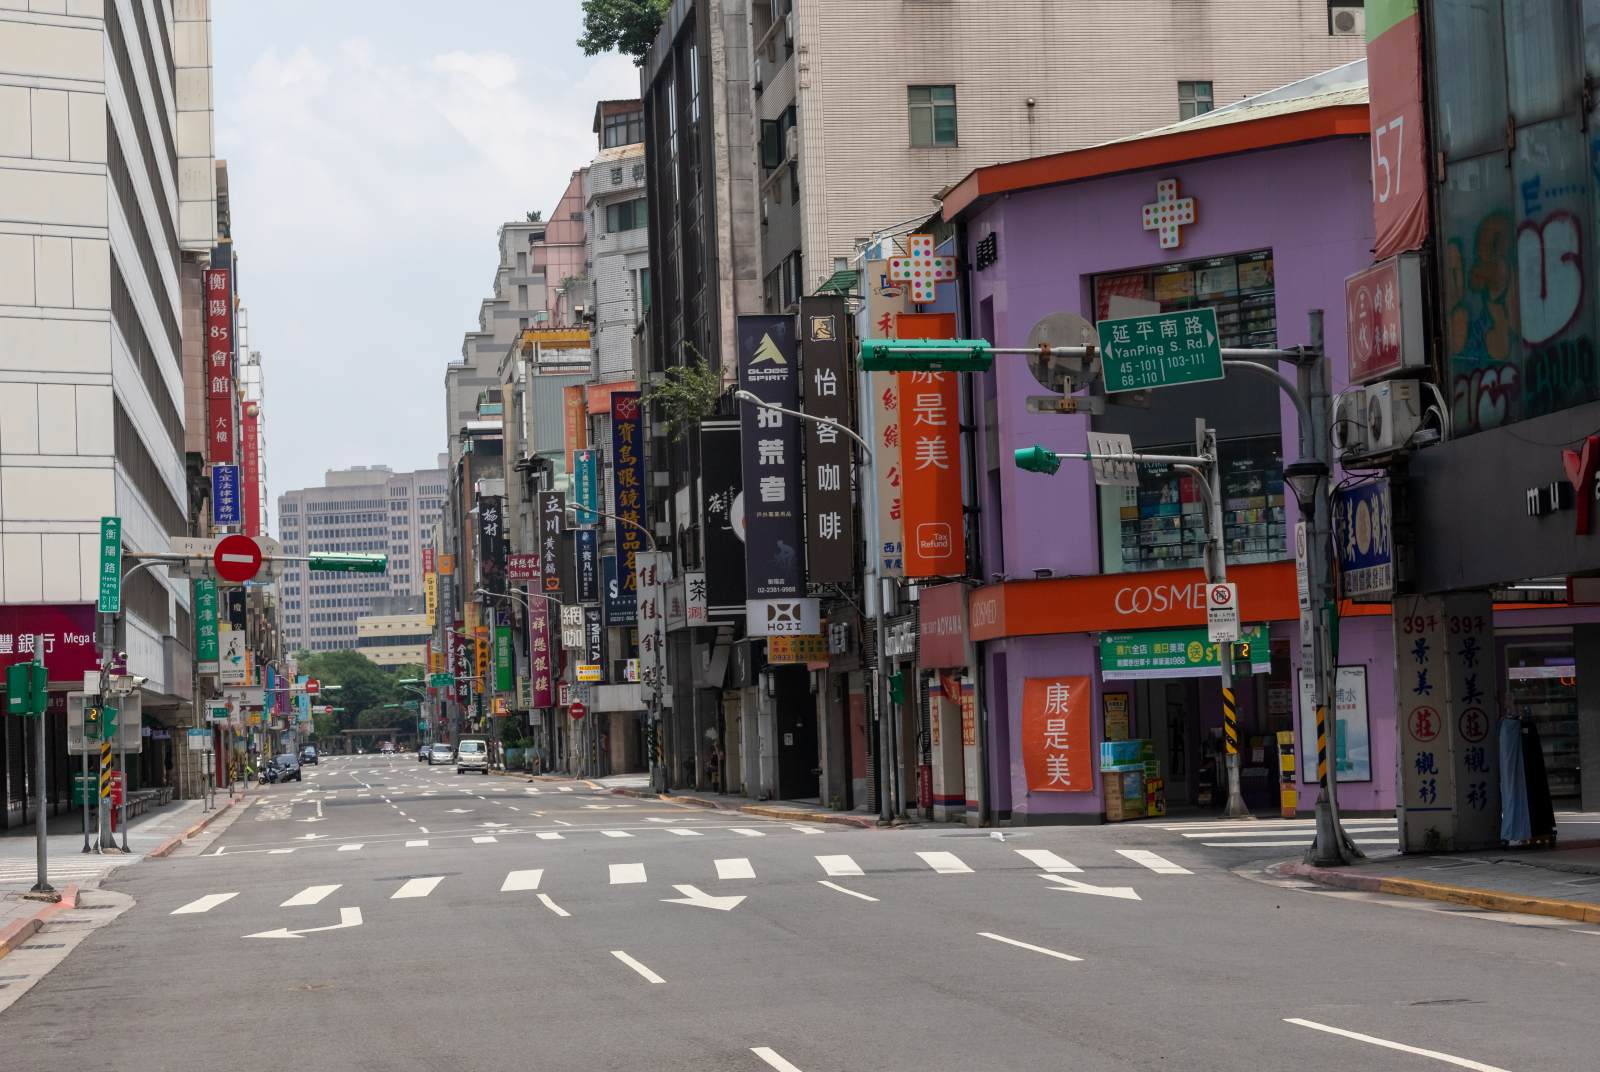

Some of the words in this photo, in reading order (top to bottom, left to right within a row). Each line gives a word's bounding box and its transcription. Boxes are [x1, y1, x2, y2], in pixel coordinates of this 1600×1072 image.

[208, 273, 228, 393] 衡陽85會館
[1112, 316, 1202, 343] 延平南路
[1115, 345, 1164, 358] YanPing
[1170, 341, 1181, 352] S.
[1187, 338, 1206, 350] Rd.
[1167, 353, 1205, 368] 103-111
[216, 417, 228, 442] 大樓
[757, 402, 786, 502] 拓荒者
[814, 367, 842, 540] 怡客咖啡
[545, 494, 562, 534] 立川
[104, 528, 116, 574] 衡陽路
[920, 540, 948, 548] Refund
[690, 579, 706, 602] 茶
[563, 606, 582, 647] 網咖
[937, 616, 962, 636] AOYAMA
[64, 632, 90, 646] Mega
[1242, 644, 1248, 656] 2
[91, 709, 96, 720] 2
[1043, 682, 1070, 786] 康是美
